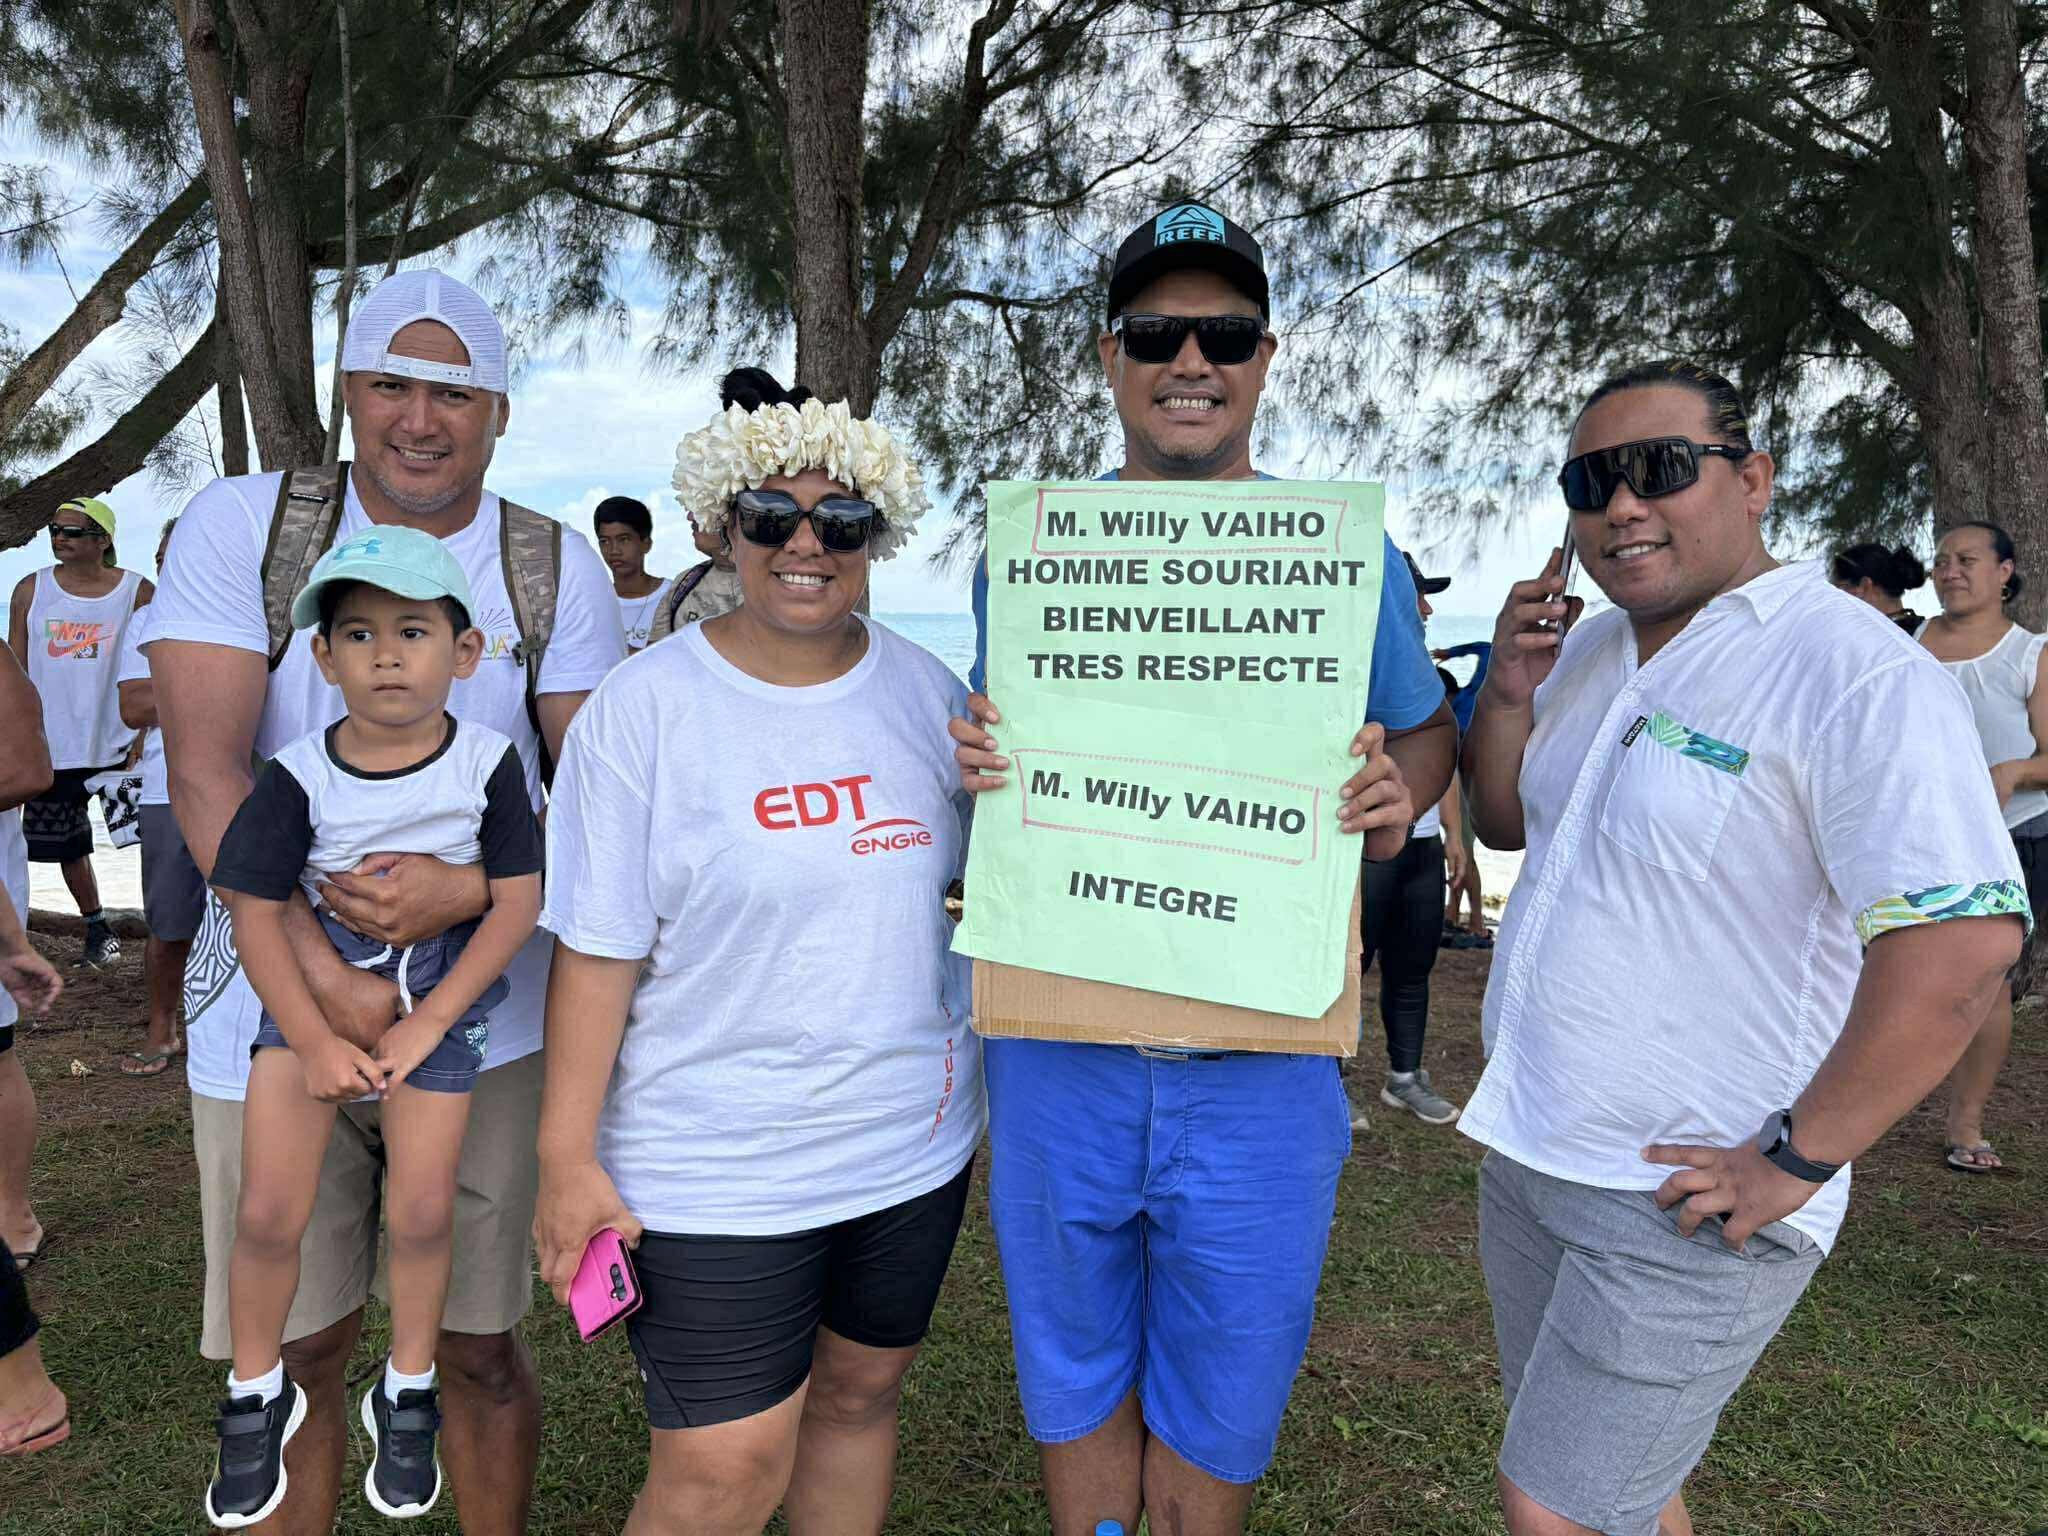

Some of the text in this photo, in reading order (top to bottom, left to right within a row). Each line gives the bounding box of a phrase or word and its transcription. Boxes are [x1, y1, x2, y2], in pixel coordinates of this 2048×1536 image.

[1159, 228, 1221, 245] REEF
[1047, 511, 1325, 544] M. Willy VAIHO
[1008, 559, 1366, 586] HOMME SOURIANT
[1043, 606, 1326, 634] BIENVEILLANT
[1027, 653, 1339, 683] TRES RESPECTE
[754, 775, 873, 831] EDT
[1030, 769, 1307, 835] M. Willy VAIHO
[1069, 871, 1239, 923] INTEGRE
